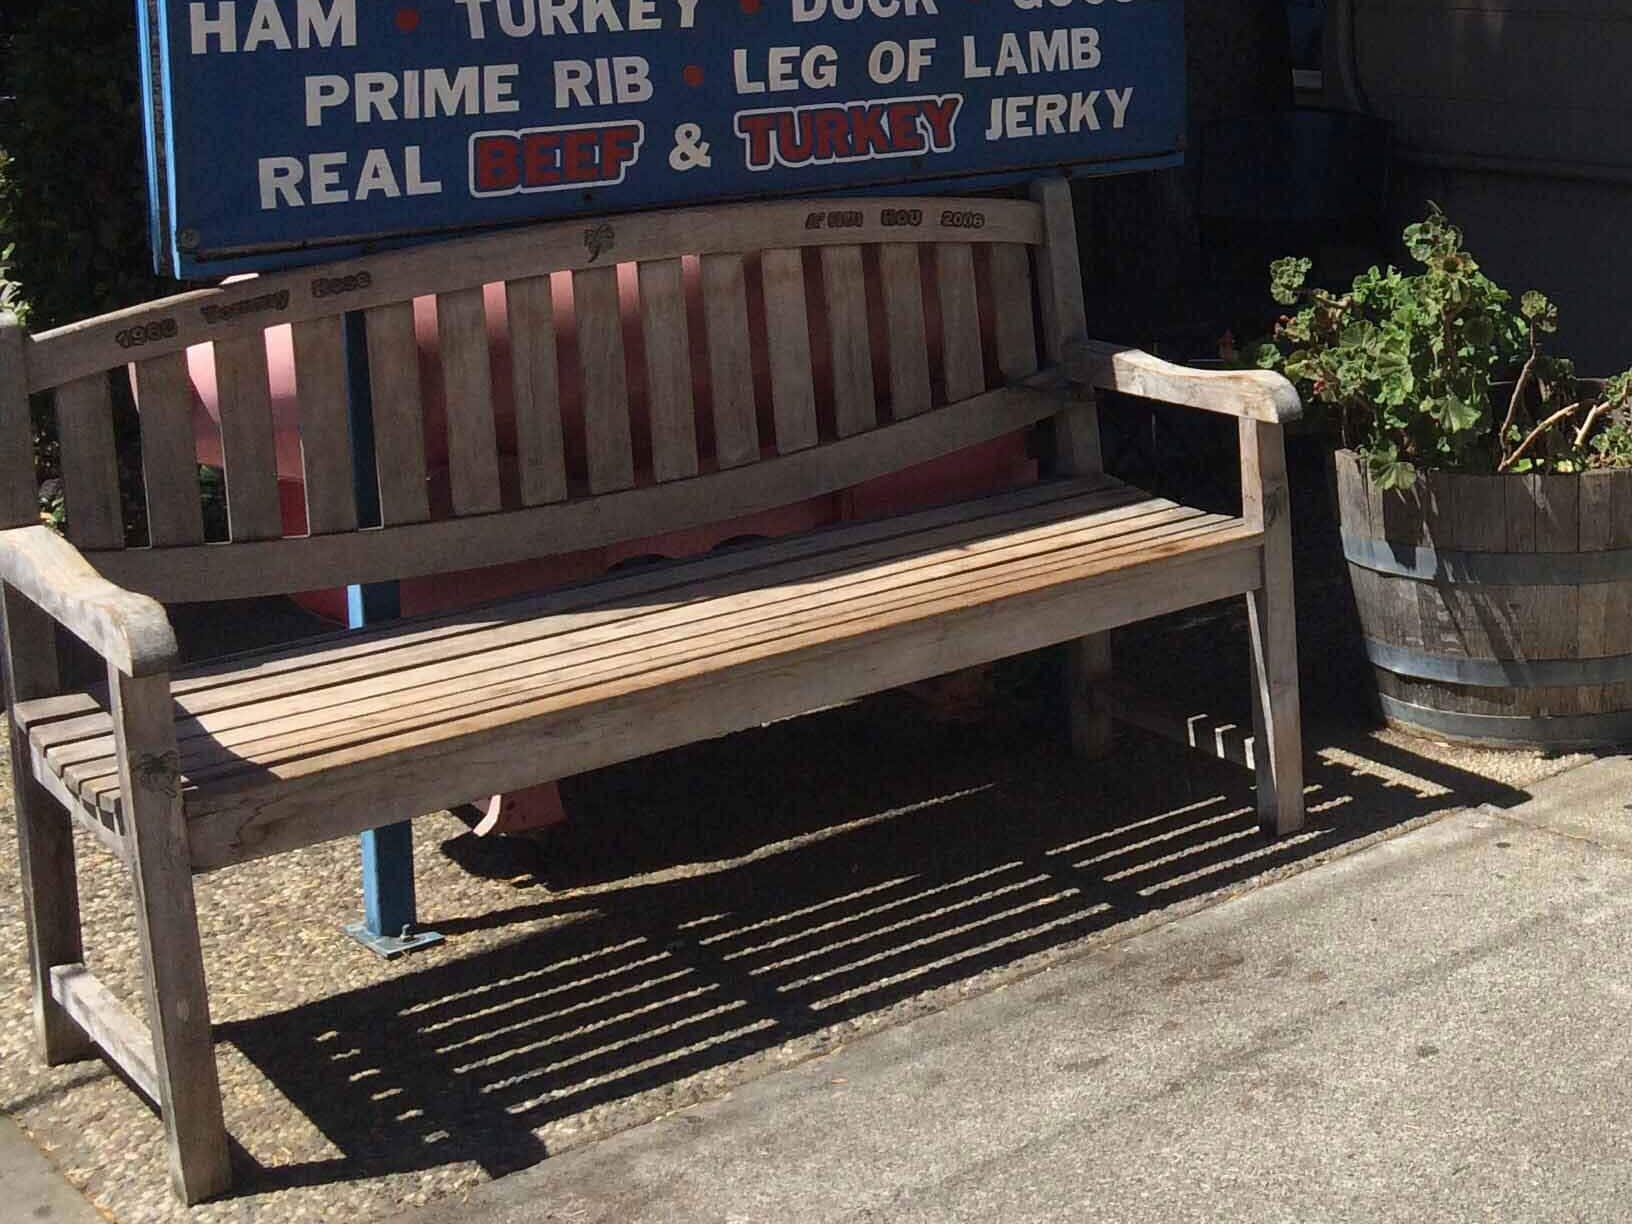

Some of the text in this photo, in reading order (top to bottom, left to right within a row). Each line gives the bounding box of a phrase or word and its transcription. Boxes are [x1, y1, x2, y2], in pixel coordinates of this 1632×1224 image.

[305, 27, 1101, 127] PRIME RIB LEG OF LAMB
[257, 87, 1134, 209] REAL BEEF & TURKEY JERKY
